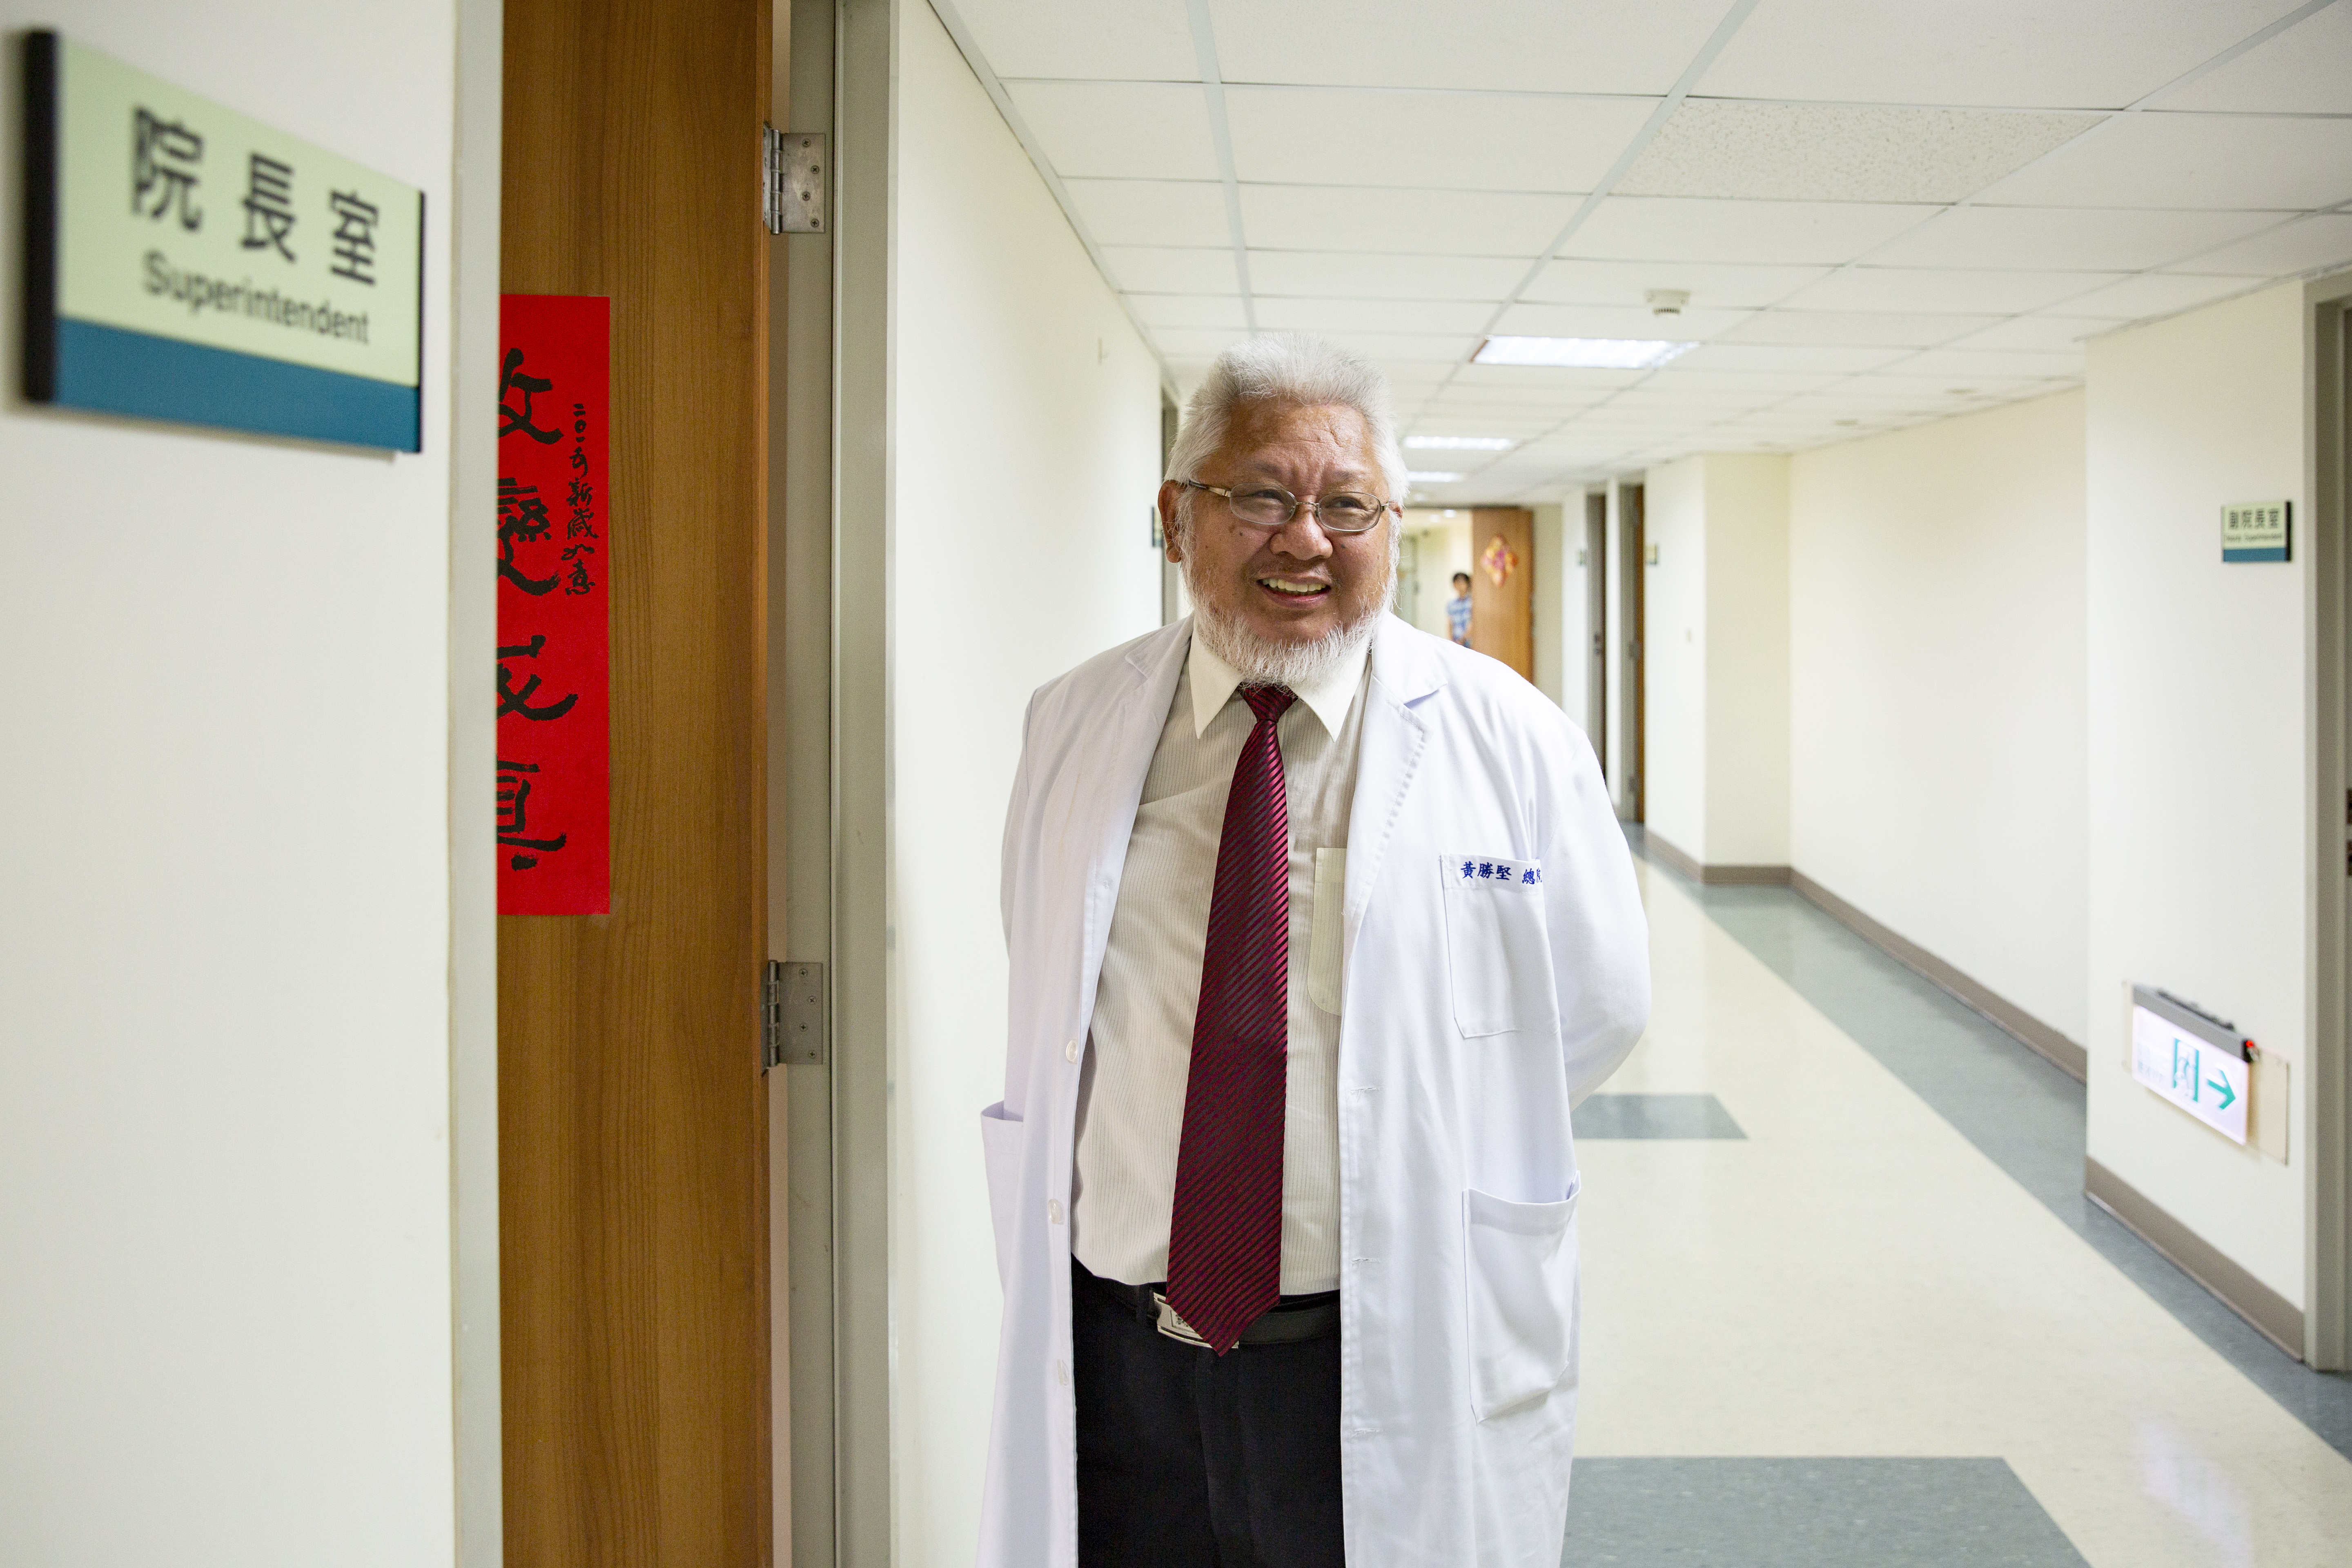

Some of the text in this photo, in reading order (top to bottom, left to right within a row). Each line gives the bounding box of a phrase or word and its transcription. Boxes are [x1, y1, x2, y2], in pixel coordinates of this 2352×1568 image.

[132, 105, 379, 285] 院長室
[144, 248, 369, 344] Superintendent
[1461, 861, 1512, 880] 黃勝堅
